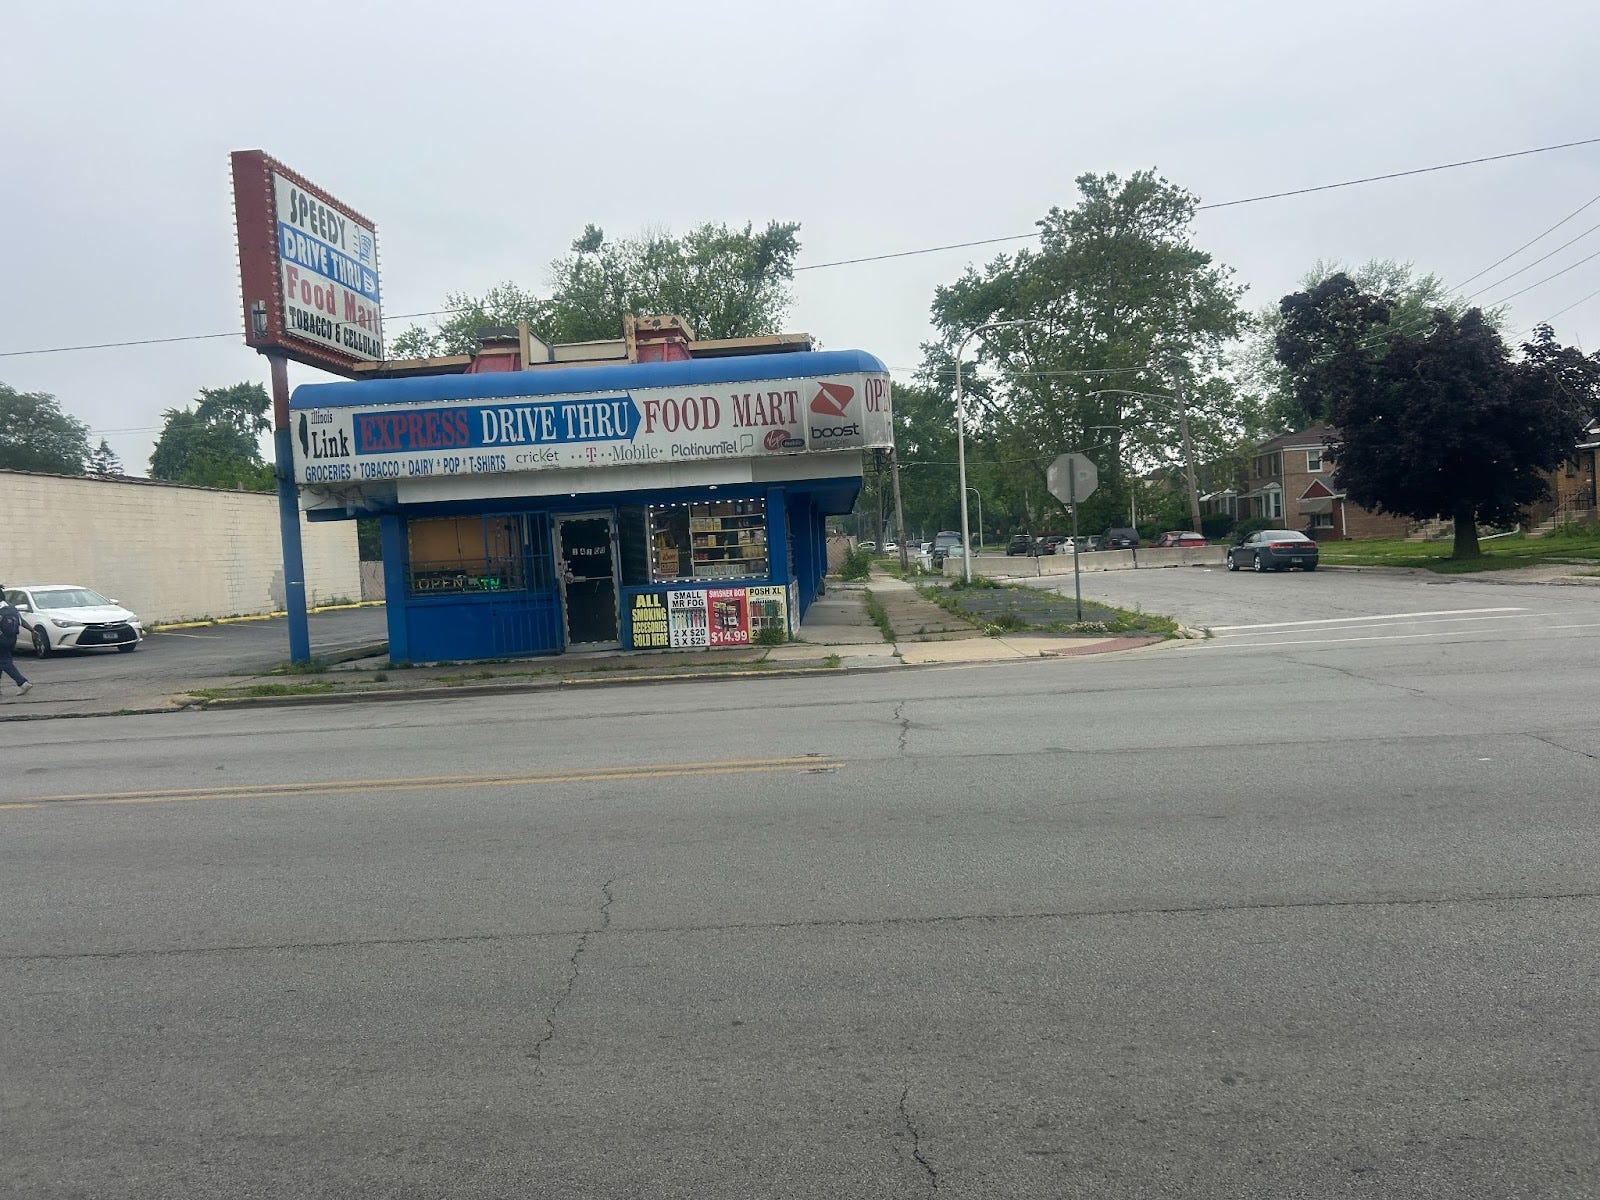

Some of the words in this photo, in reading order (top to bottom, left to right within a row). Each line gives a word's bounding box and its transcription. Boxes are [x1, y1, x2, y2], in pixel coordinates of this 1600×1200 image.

[290, 188, 346, 250] SPEEDY
[282, 227, 329, 275] DRIVE
[329, 248, 362, 291] THRU
[286, 264, 336, 316] Food
[343, 289, 379, 336] Mart
[289, 306, 332, 340] TOBACCO
[335, 323, 341, 343] &
[343, 327, 381, 359] CELLULAR
[311, 410, 333, 425] Illinois
[360, 410, 470, 451] EXPRESS
[480, 406, 557, 444] DRIVE
[562, 401, 629, 440] THRU
[643, 396, 720, 434] FOOD
[731, 391, 799, 428] MART
[811, 422, 860, 439] boost
[312, 428, 350, 459] Link
[671, 440, 738, 457] PlatinumTel
[516, 447, 560, 464] cricket
[305, 463, 351, 481] GROCERIES
[360, 461, 400, 478] TOBACCO
[408, 459, 434, 475] DAIRY
[443, 457, 460, 473] POP
[469, 454, 506, 472] T-SHIRTS
[673, 591, 702, 600] SMALL
[734, 588, 746, 597] BOX
[750, 587, 769, 596] POSH
[773, 587, 782, 595] XL
[635, 594, 662, 608] ALL
[672, 600, 684, 608] MR
[687, 599, 704, 607] FOG
[632, 607, 667, 621] SMOKING
[633, 634, 651, 647] SOLD
[651, 632, 669, 646] HERE
[690, 628, 705, 637] $20
[711, 630, 748, 643] $14.99
[752, 629, 758, 637] 2
[674, 638, 680, 646] 3
[682, 638, 688, 646] X
[691, 637, 706, 645] $25
